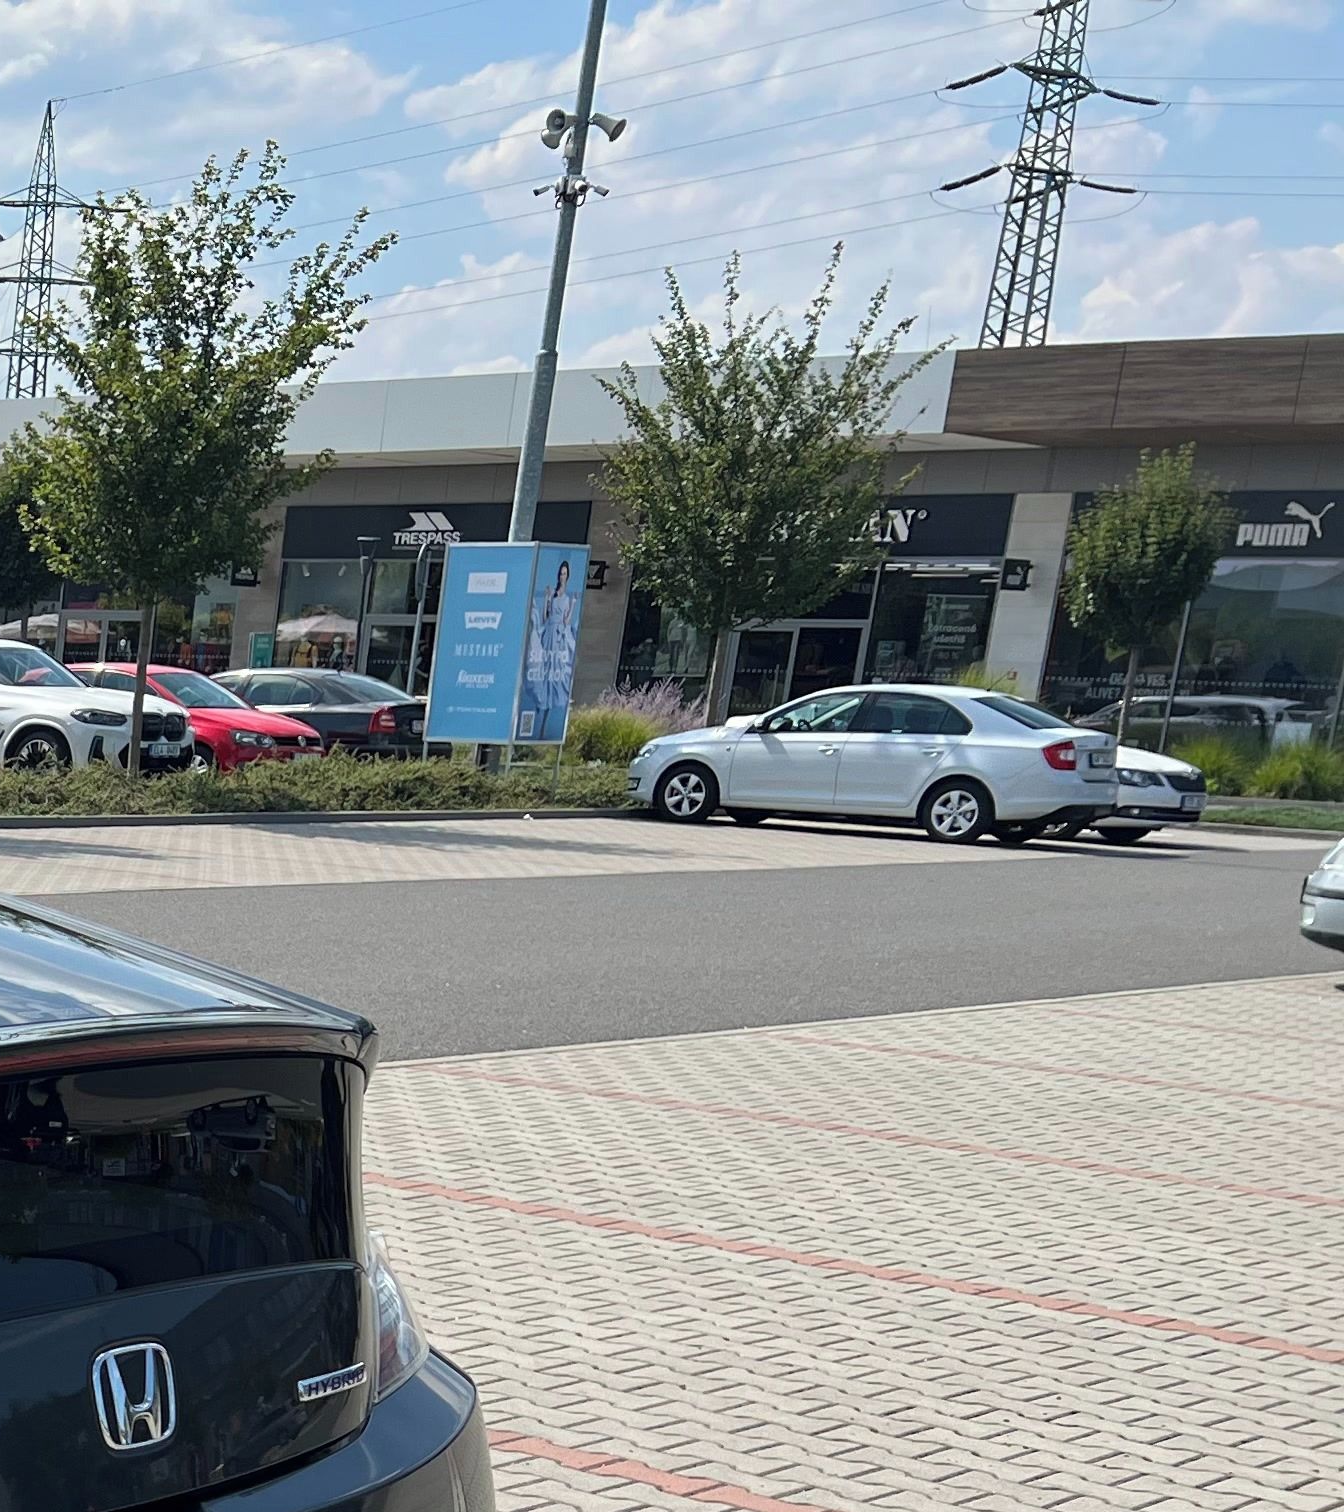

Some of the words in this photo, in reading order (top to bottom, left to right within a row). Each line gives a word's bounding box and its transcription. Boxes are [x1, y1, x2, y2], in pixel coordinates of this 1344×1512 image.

[392, 532, 462, 545] TRESPASS
[1235, 523, 1310, 546] PUMA
[307, 1367, 365, 1397] HYBRID
